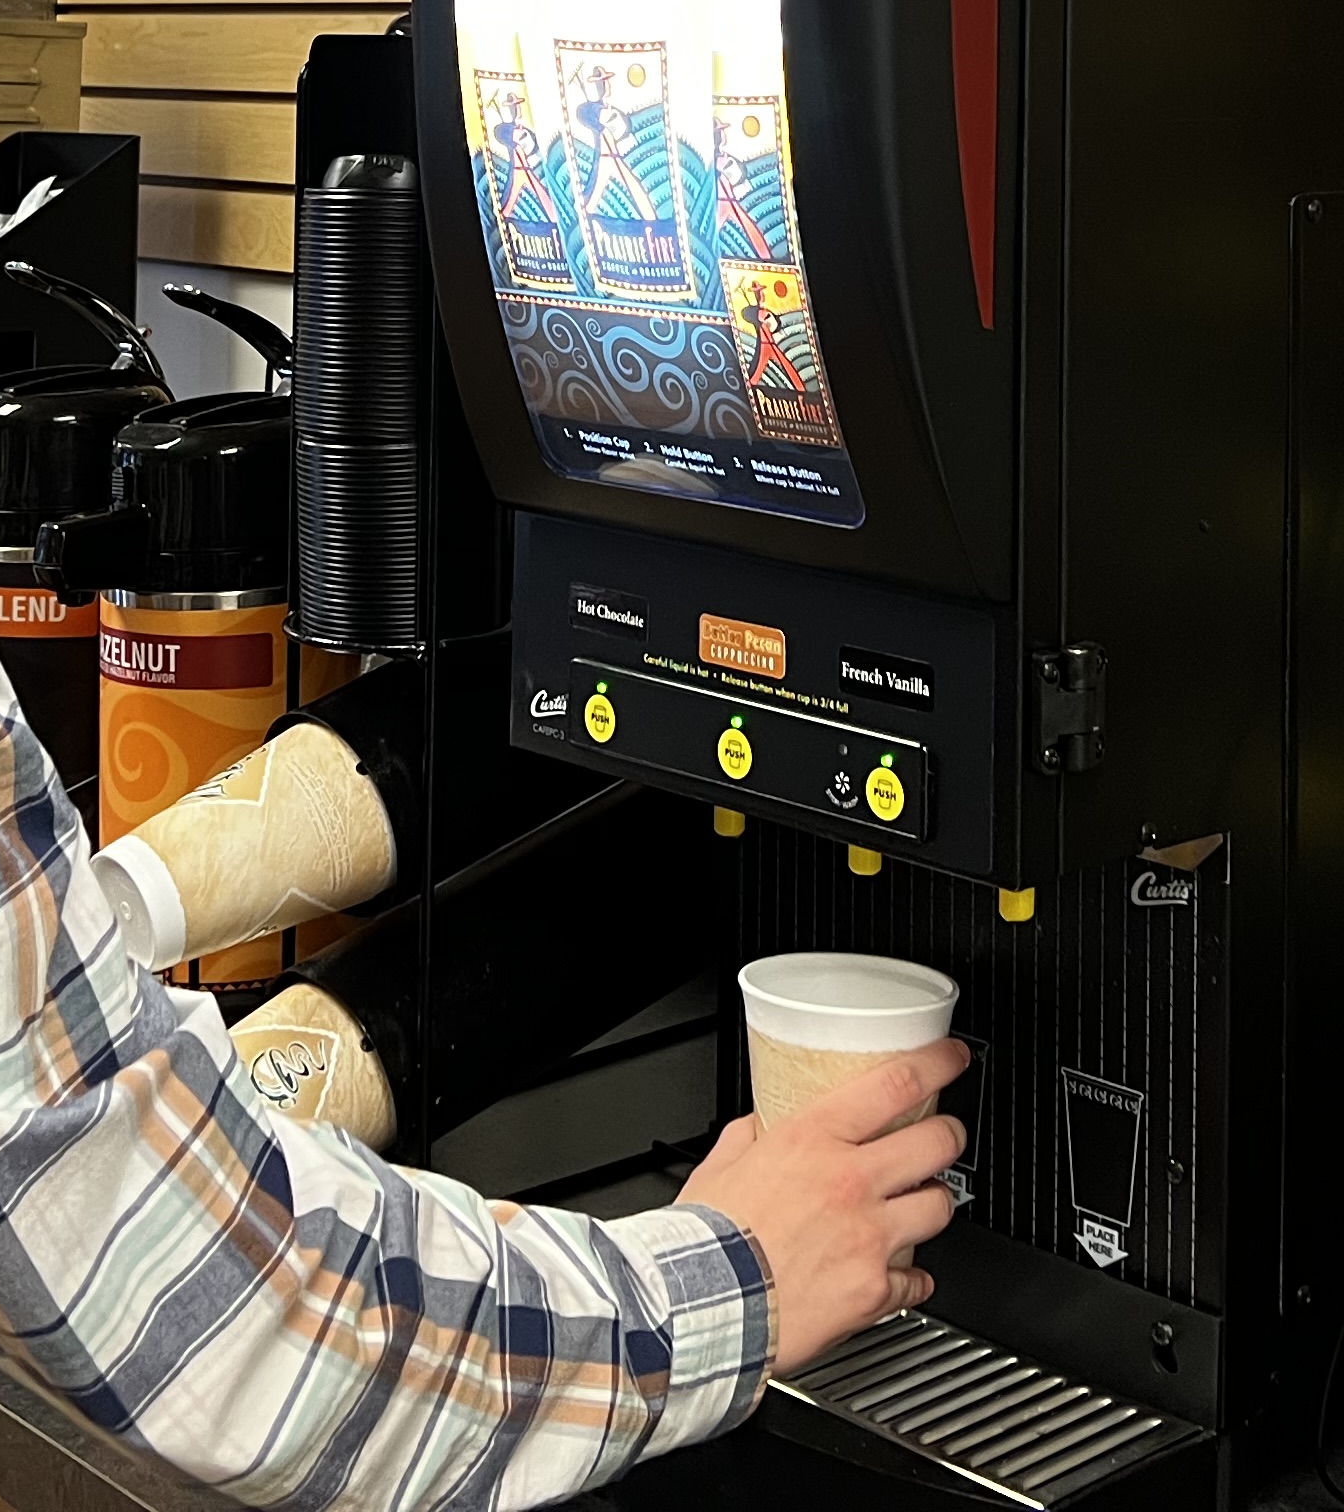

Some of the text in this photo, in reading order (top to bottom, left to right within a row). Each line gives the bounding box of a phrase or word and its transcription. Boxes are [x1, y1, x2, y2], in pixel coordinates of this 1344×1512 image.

[577, 599, 645, 629] Hot Chocolate
[721, 672, 748, 689] Release
[797, 692, 811, 706] cup
[841, 661, 931, 698] French Vanilla
[591, 712, 610, 725] PUSH
[724, 747, 746, 761] PUSH
[873, 787, 898, 802] PUSH
[1131, 871, 1193, 906] Curtis
[1086, 1223, 1116, 1245] PLACE
[1088, 1240, 1115, 1259] HERE
